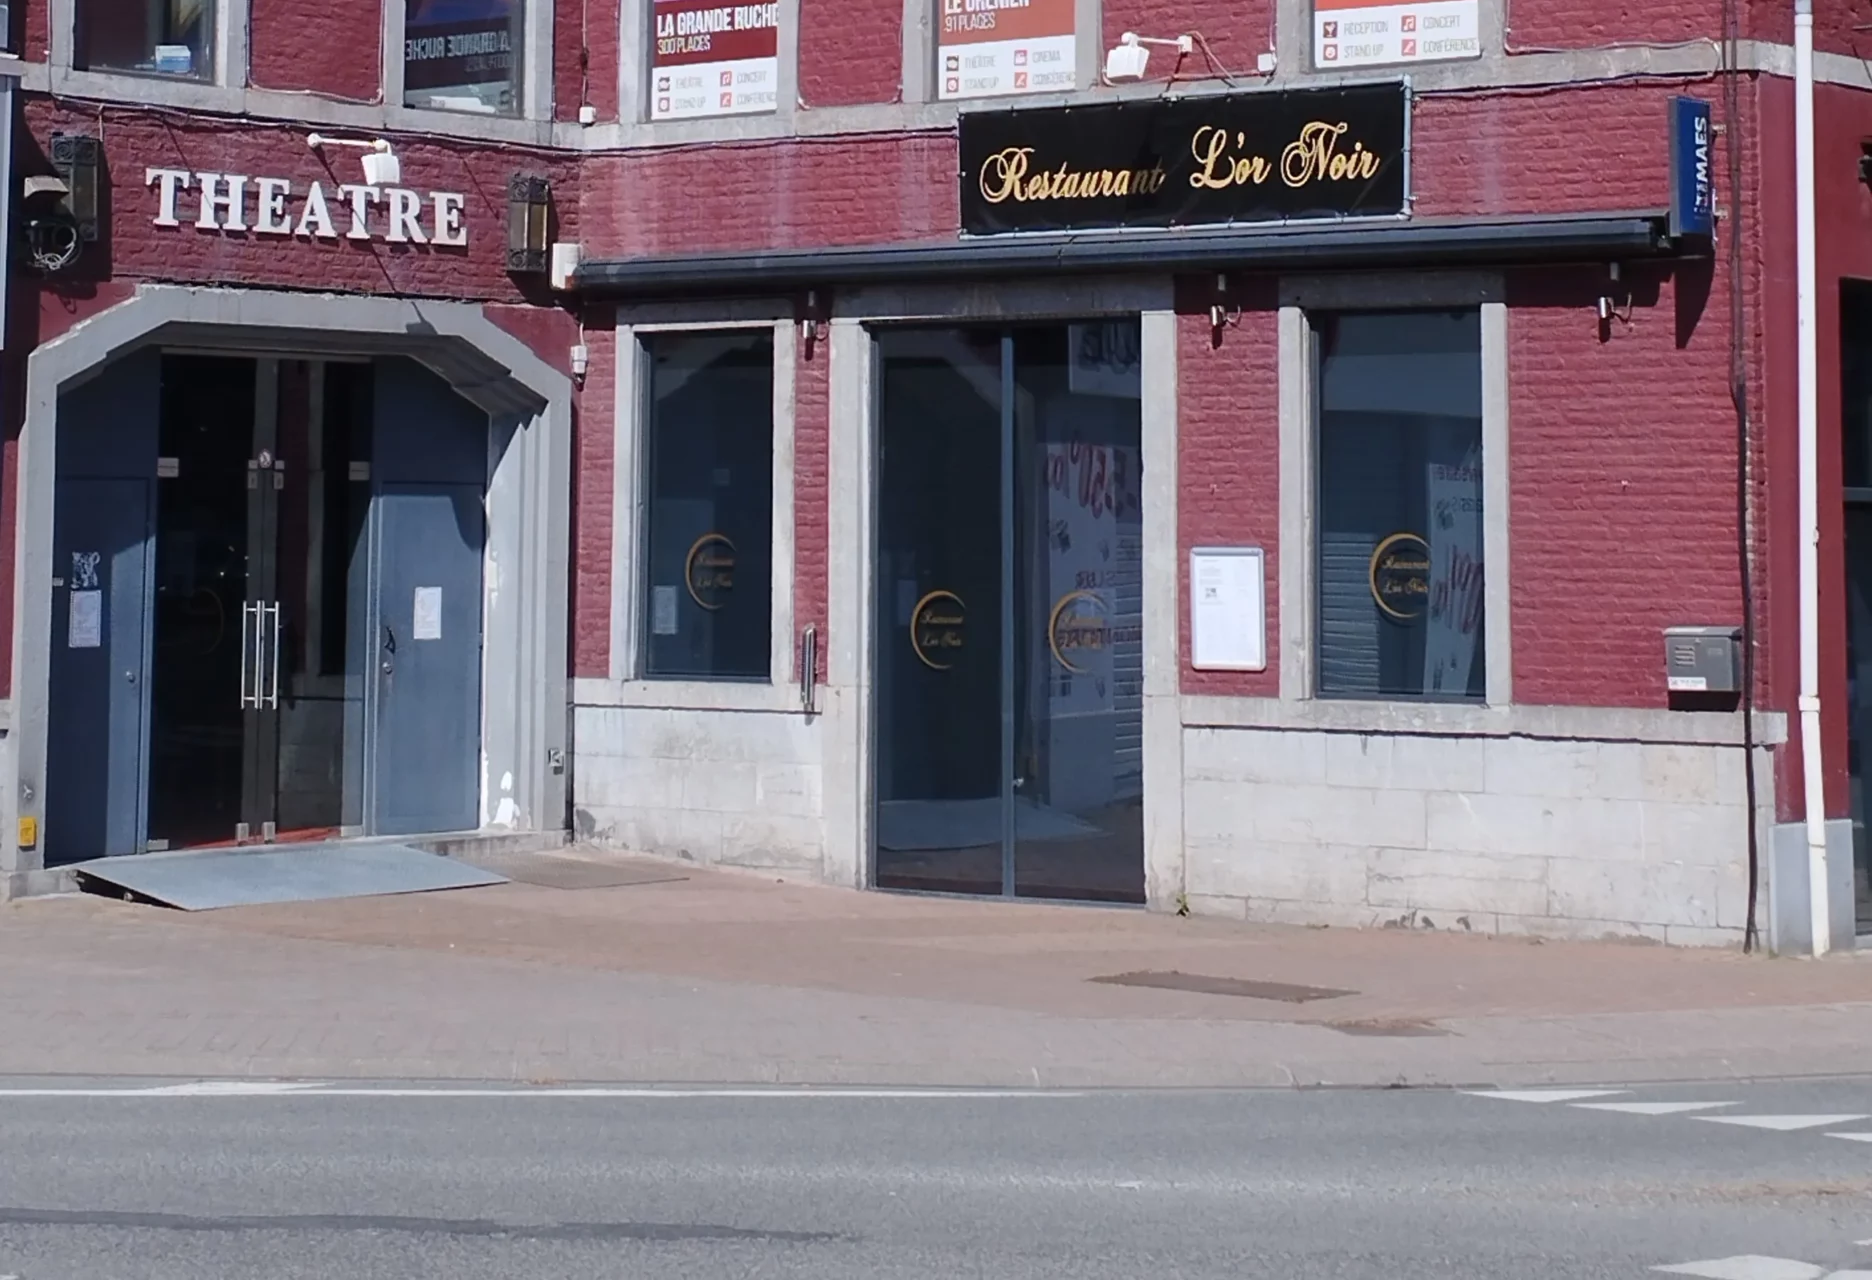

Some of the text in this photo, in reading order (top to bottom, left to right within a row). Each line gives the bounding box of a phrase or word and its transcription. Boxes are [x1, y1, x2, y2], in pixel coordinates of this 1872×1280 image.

[657, 13, 675, 38] LA
[677, 7, 733, 35] GRANDE
[959, 11, 996, 33] PLACES
[979, 121, 1380, 203] Restaurant L'or Noir
[1694, 116, 1709, 183] MAES
[145, 167, 467, 246] THEATRE
